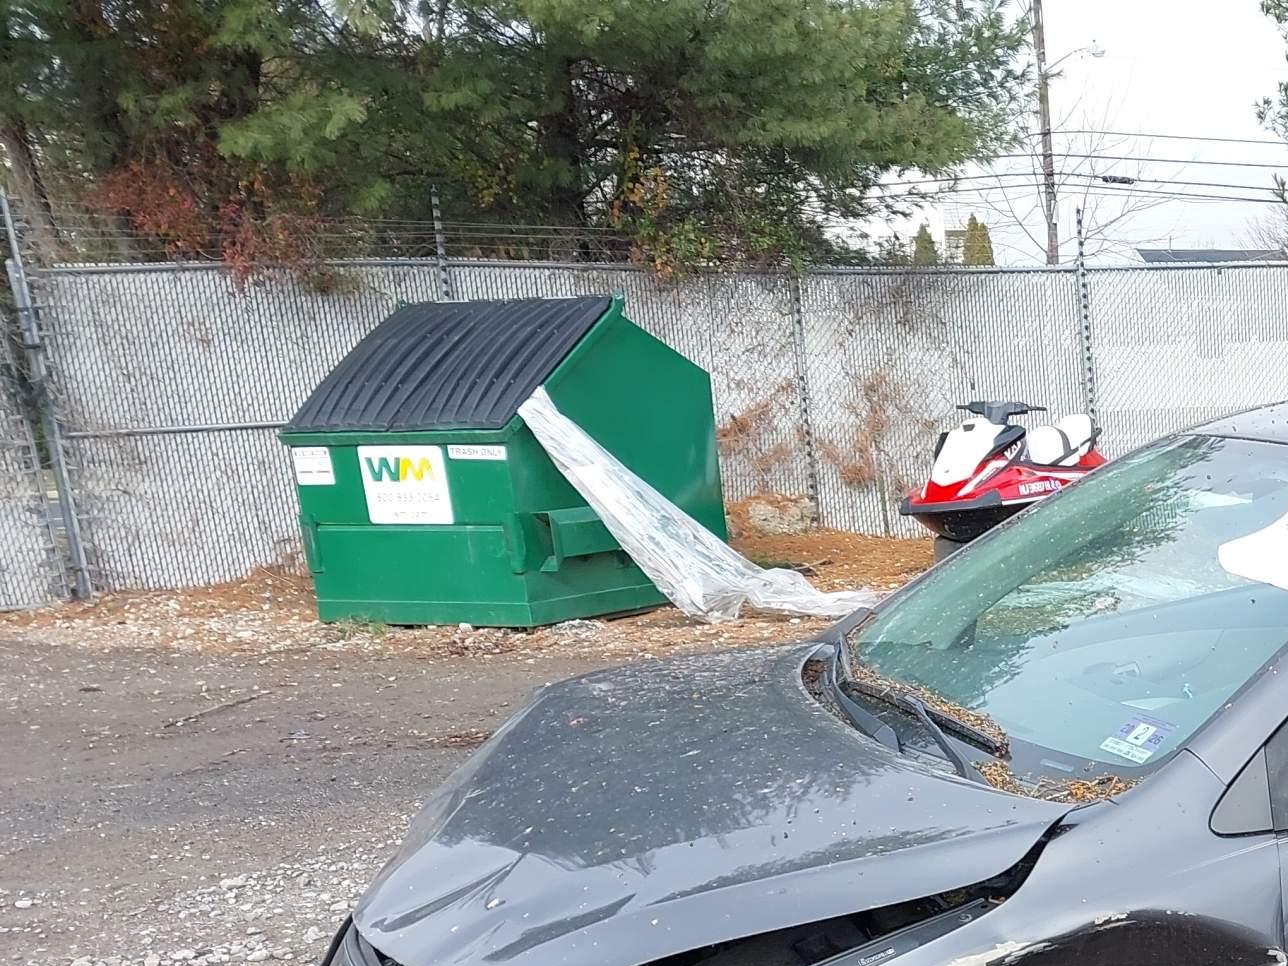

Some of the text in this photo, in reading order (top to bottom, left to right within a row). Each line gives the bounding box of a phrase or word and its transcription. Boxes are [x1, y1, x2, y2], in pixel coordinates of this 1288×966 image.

[449, 447, 502, 457] TRASH ONLY
[364, 456, 436, 482] WM
